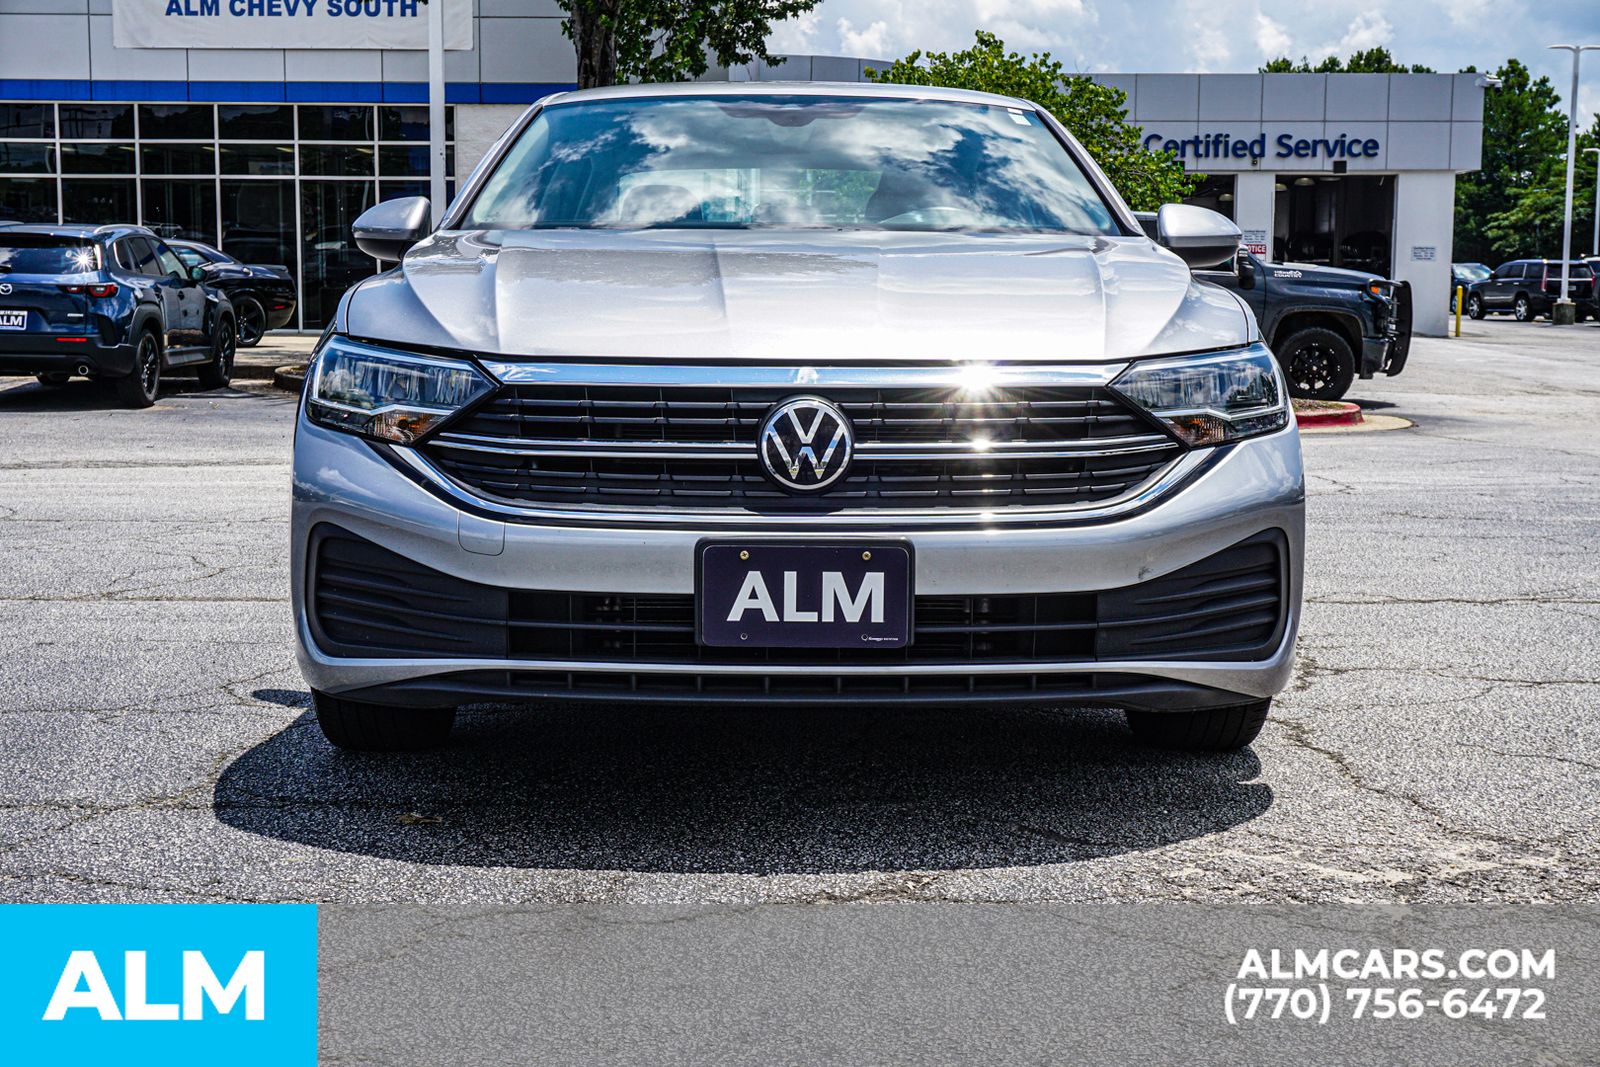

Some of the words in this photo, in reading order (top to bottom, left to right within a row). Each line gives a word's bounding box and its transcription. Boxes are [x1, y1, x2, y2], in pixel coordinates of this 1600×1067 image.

[165, 0, 220, 17] ALM
[228, 0, 317, 17] CHEVY
[326, 0, 418, 18] SOUTH
[1142, 133, 1266, 159] Certified
[1275, 133, 1380, 159] Service
[1248, 245, 1266, 253] OTICE
[726, 570, 885, 623] ALM
